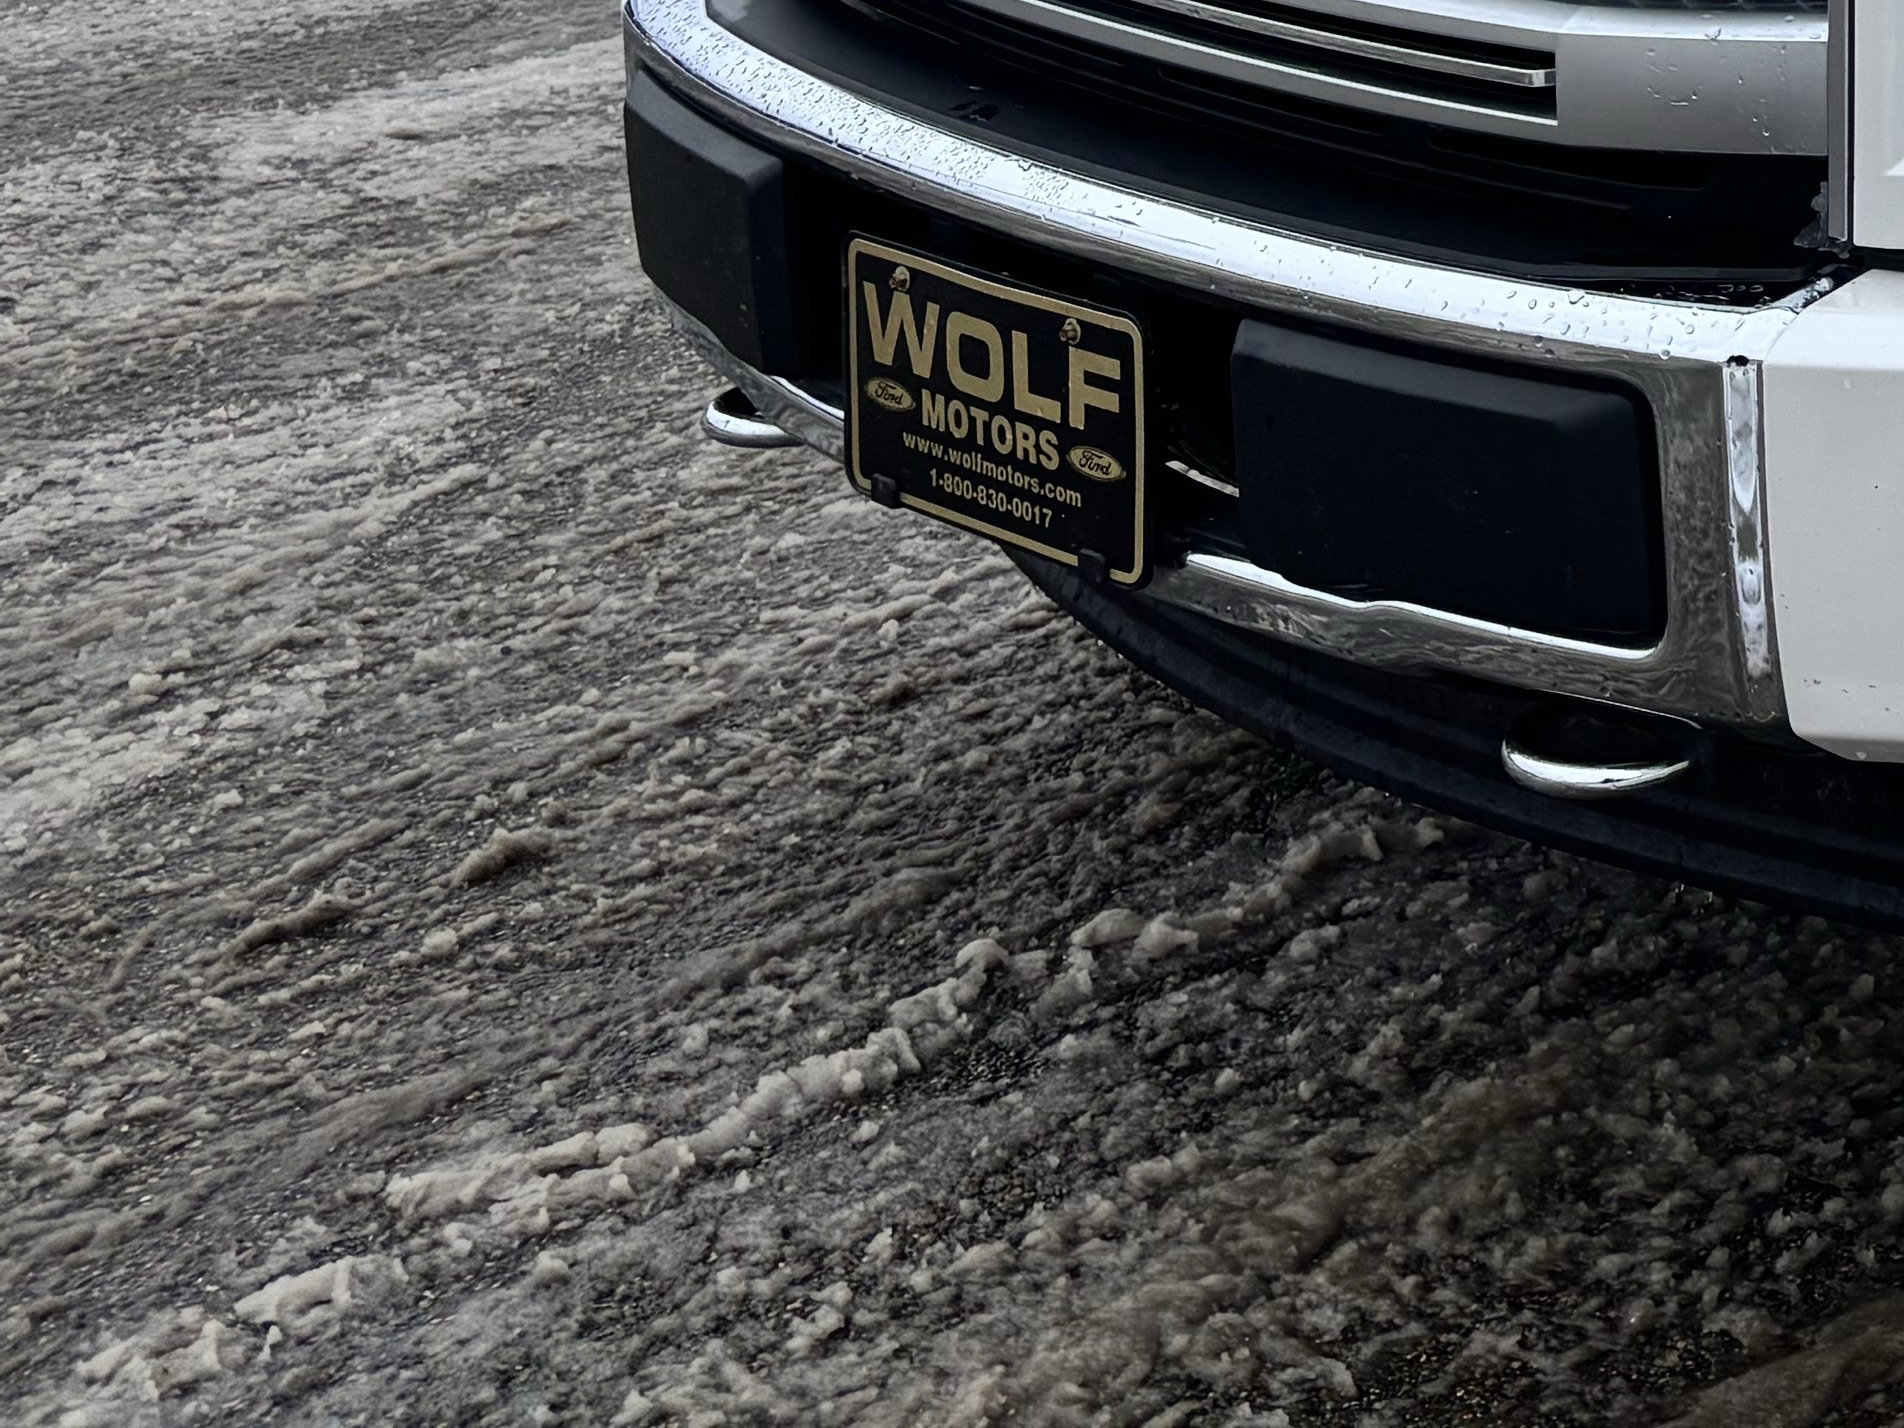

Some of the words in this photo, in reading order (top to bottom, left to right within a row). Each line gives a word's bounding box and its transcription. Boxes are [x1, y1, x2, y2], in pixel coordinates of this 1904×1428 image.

[862, 280, 1121, 431] WOLF
[902, 431, 1082, 507] www.wolfmotors.com
[921, 388, 1060, 471] MOTORS
[929, 469, 1053, 528] 1-800-830-0017
